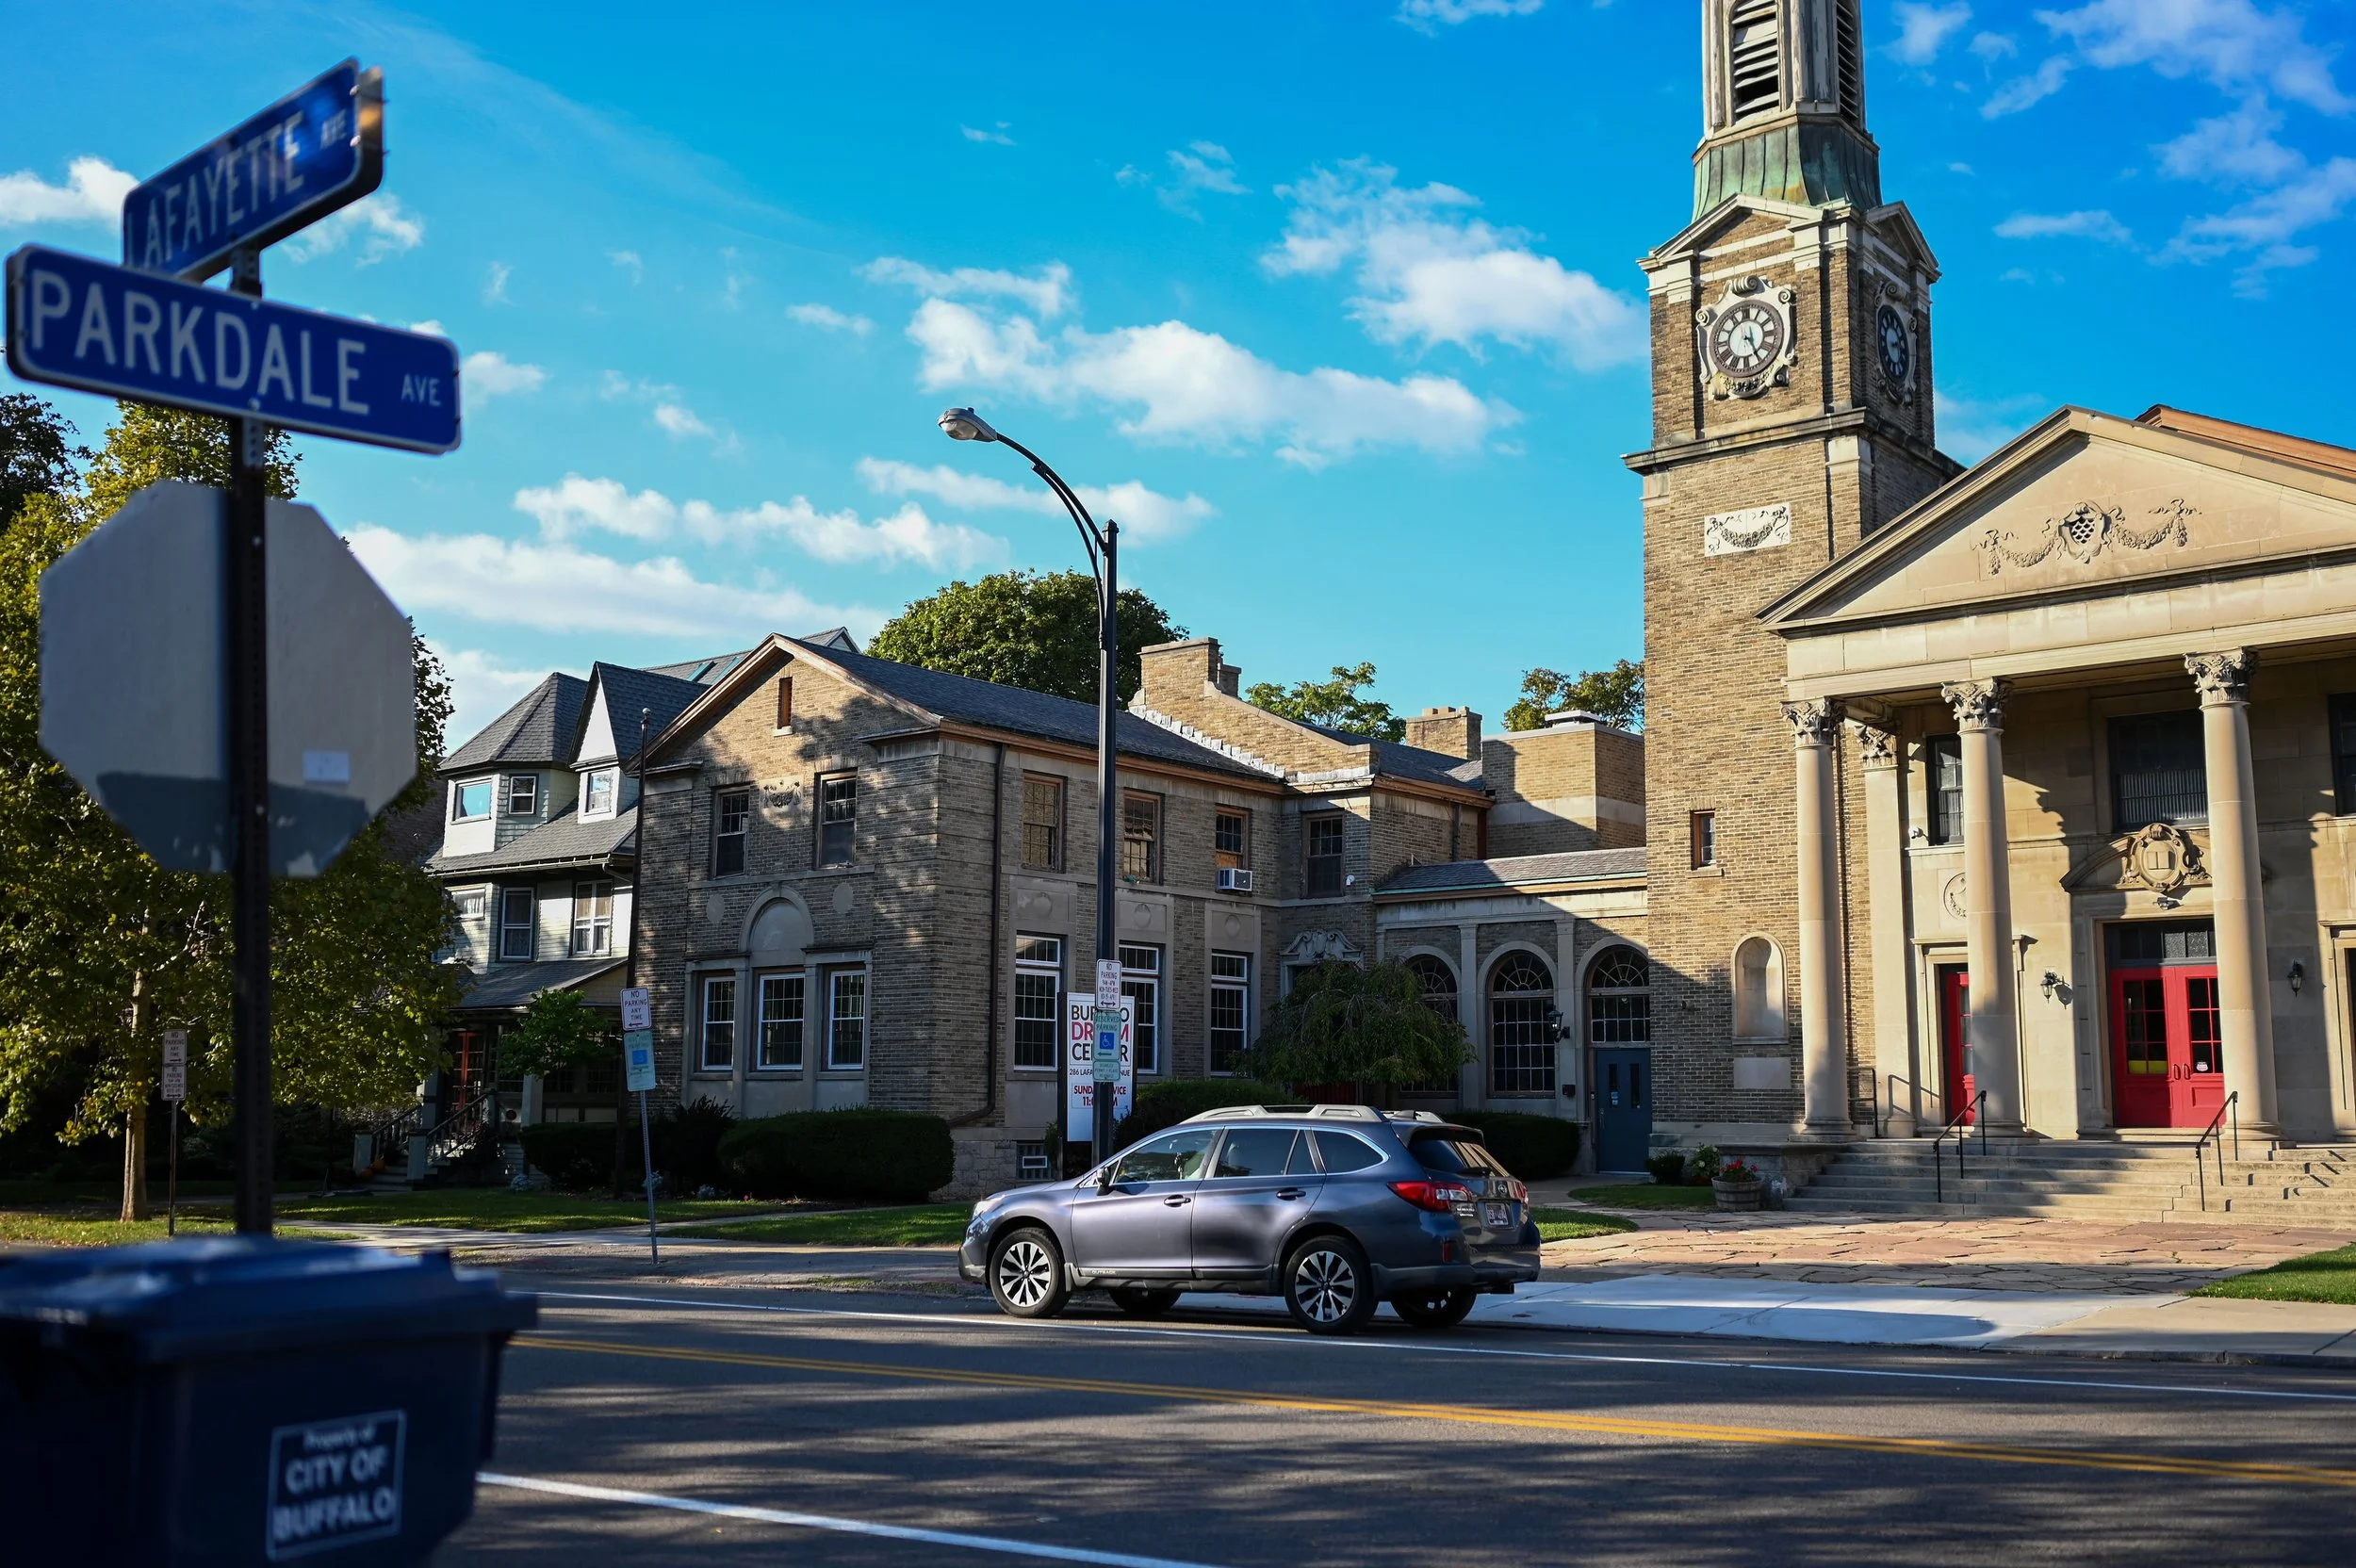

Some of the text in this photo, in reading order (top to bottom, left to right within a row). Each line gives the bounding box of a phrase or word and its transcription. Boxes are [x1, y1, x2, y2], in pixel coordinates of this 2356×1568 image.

[126, 110, 347, 270] LAFAYETTE AVE
[31, 269, 442, 415] PARKDALE AVE
[1101, 971, 1118, 980] PARKING
[1072, 1021, 1129, 1042] DRM
[1094, 1015, 1121, 1023] RESERVED
[286, 1444, 388, 1494] CITY OF
[272, 1486, 397, 1542] BUFFALO
